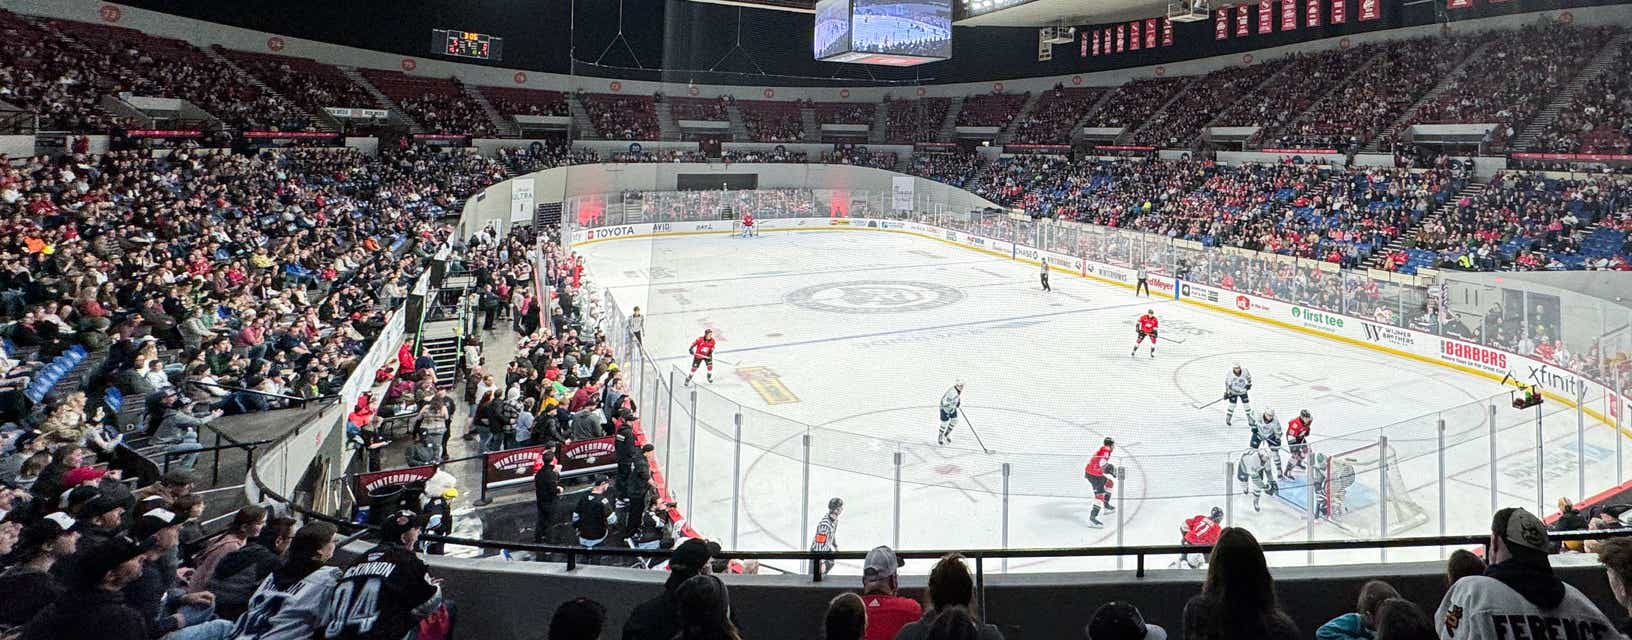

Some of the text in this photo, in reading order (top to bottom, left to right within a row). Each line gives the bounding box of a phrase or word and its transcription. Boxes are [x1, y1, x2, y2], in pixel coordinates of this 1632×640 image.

[596, 226, 634, 239] TOYOTA
[1303, 308, 1323, 323] first
[1325, 314, 1344, 327] tee
[1528, 364, 1589, 399] xfinity
[566, 442, 616, 458] WINTERHAWKS
[494, 452, 541, 470] WINTERHAW
[366, 473, 428, 491] WINTERHAW
